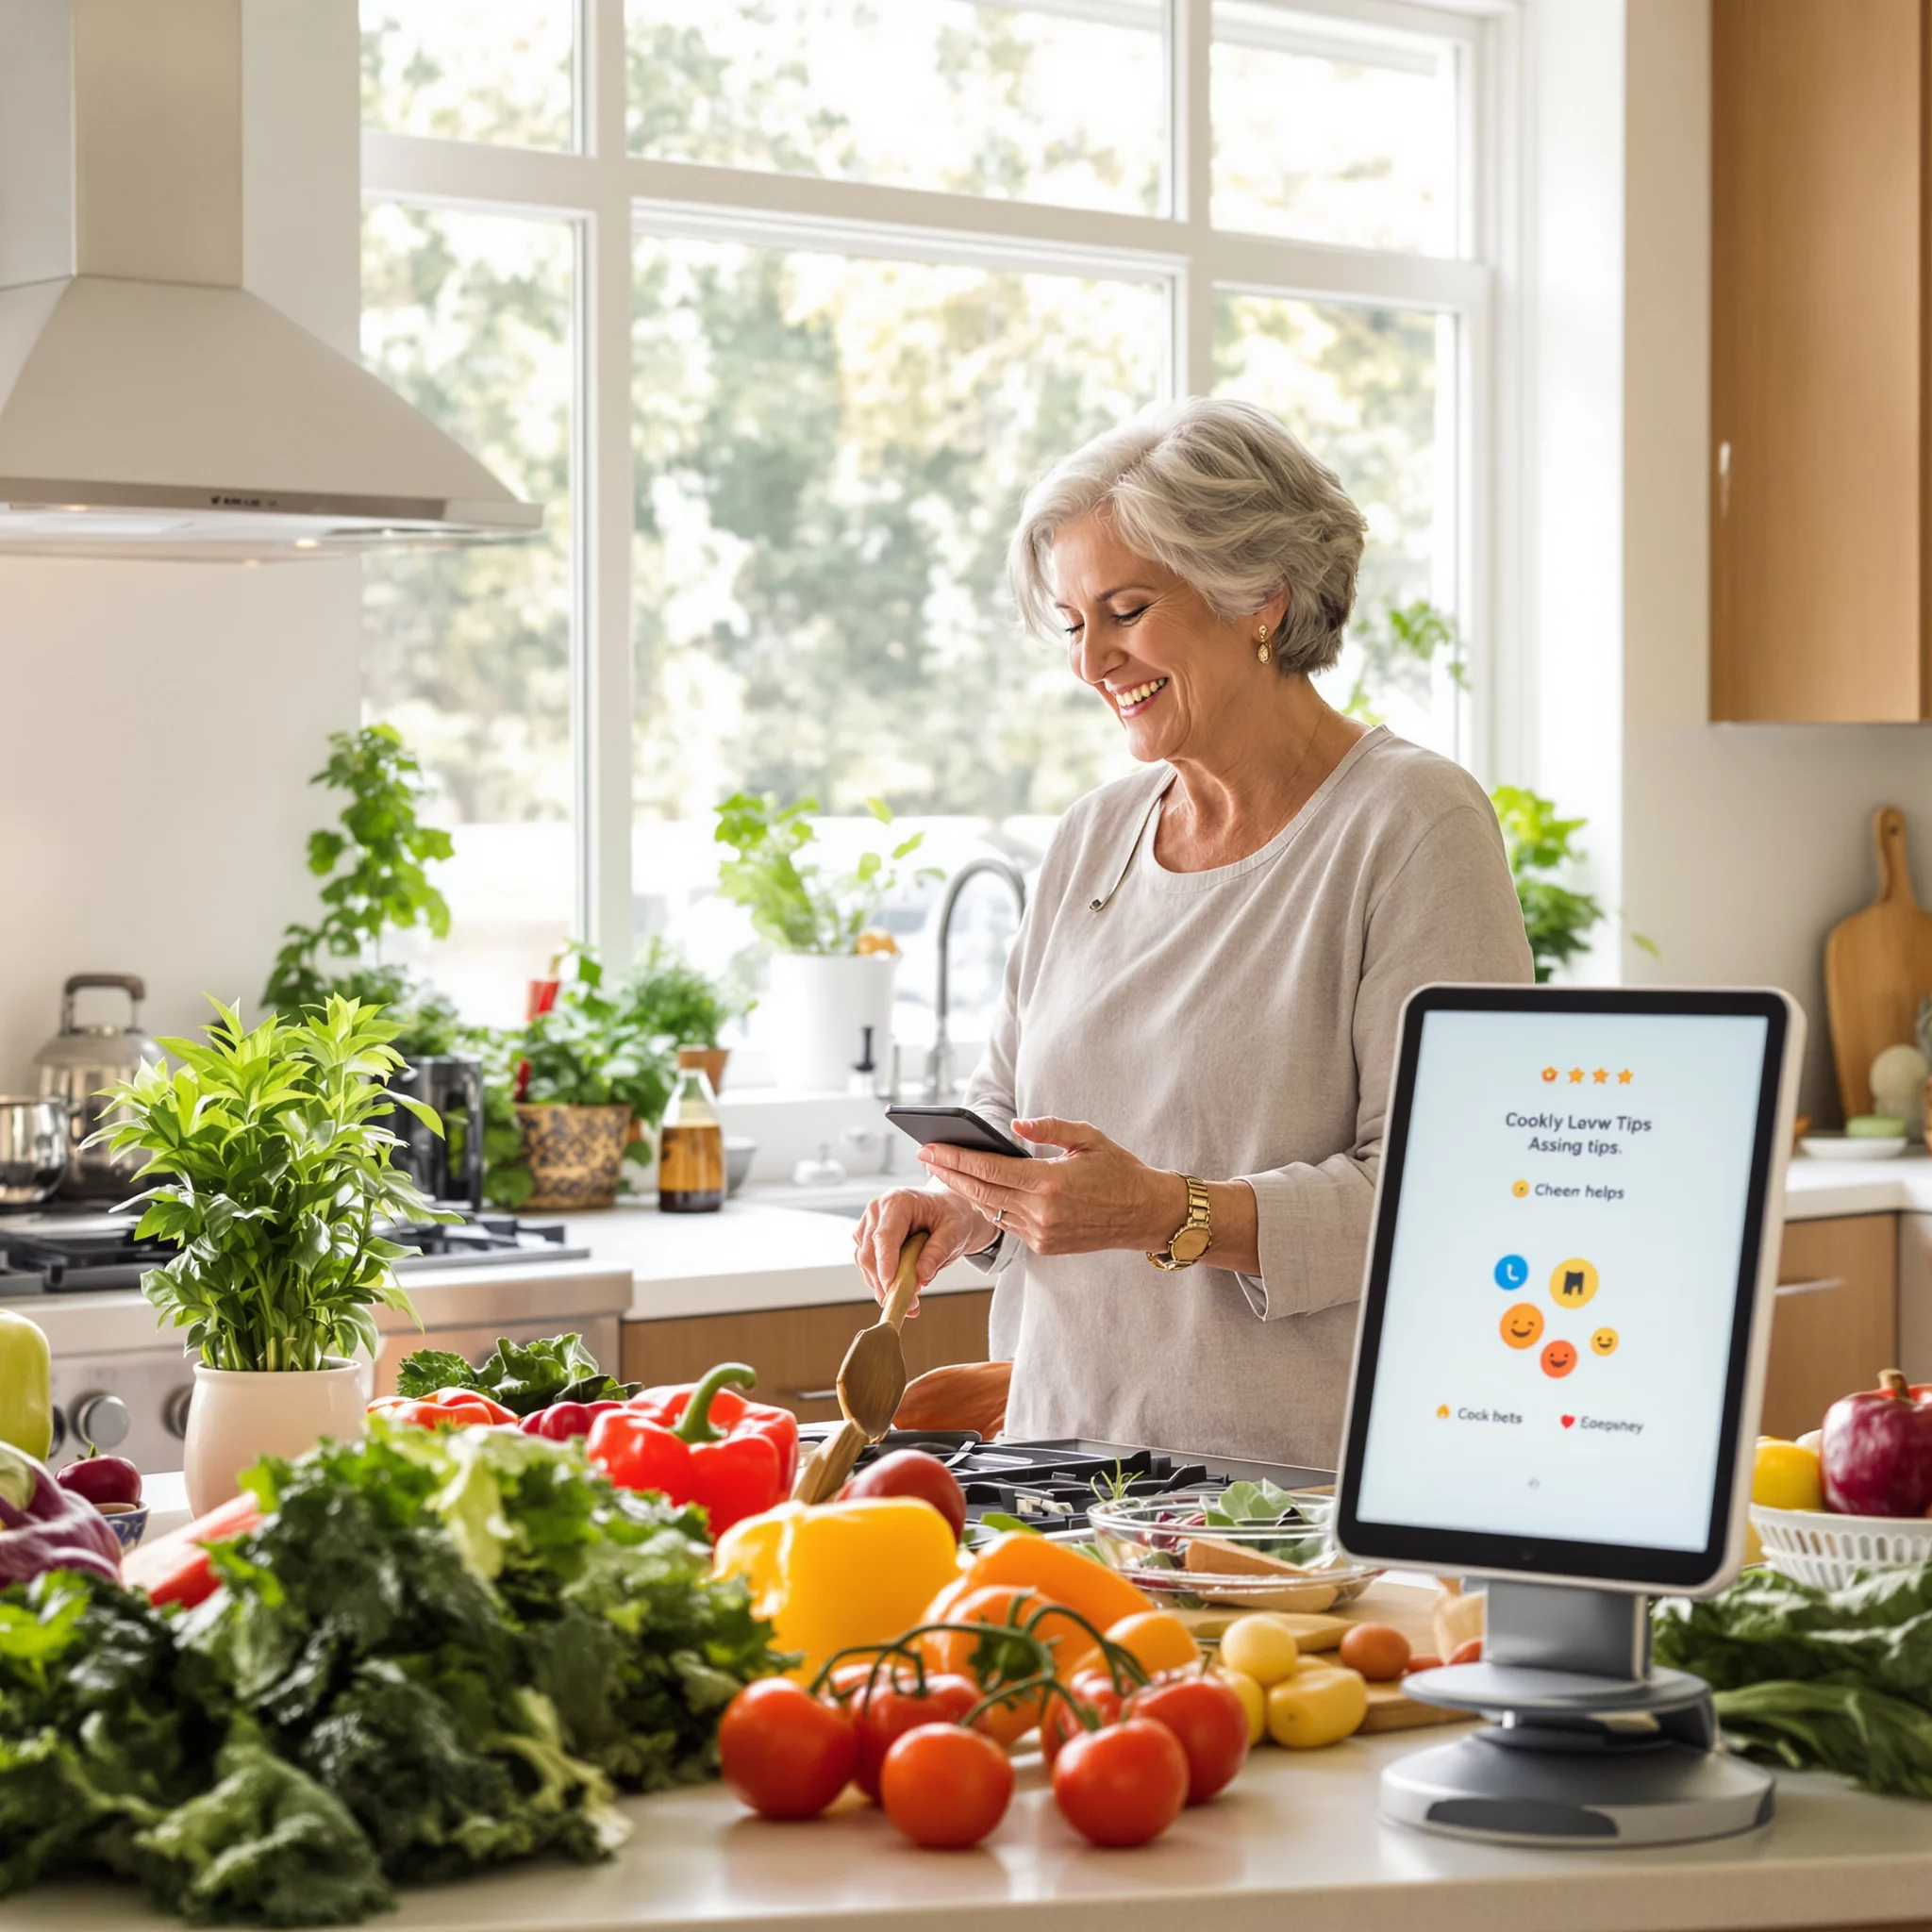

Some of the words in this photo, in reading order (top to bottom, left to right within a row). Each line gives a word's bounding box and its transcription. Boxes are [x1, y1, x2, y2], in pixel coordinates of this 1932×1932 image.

[1505, 1111, 1564, 1133] Cookly
[1616, 1115, 1653, 1135] Tips
[1528, 1136, 1583, 1157] Assing
[1588, 1139, 1623, 1158] tips.
[1585, 1184, 1624, 1202] helps
